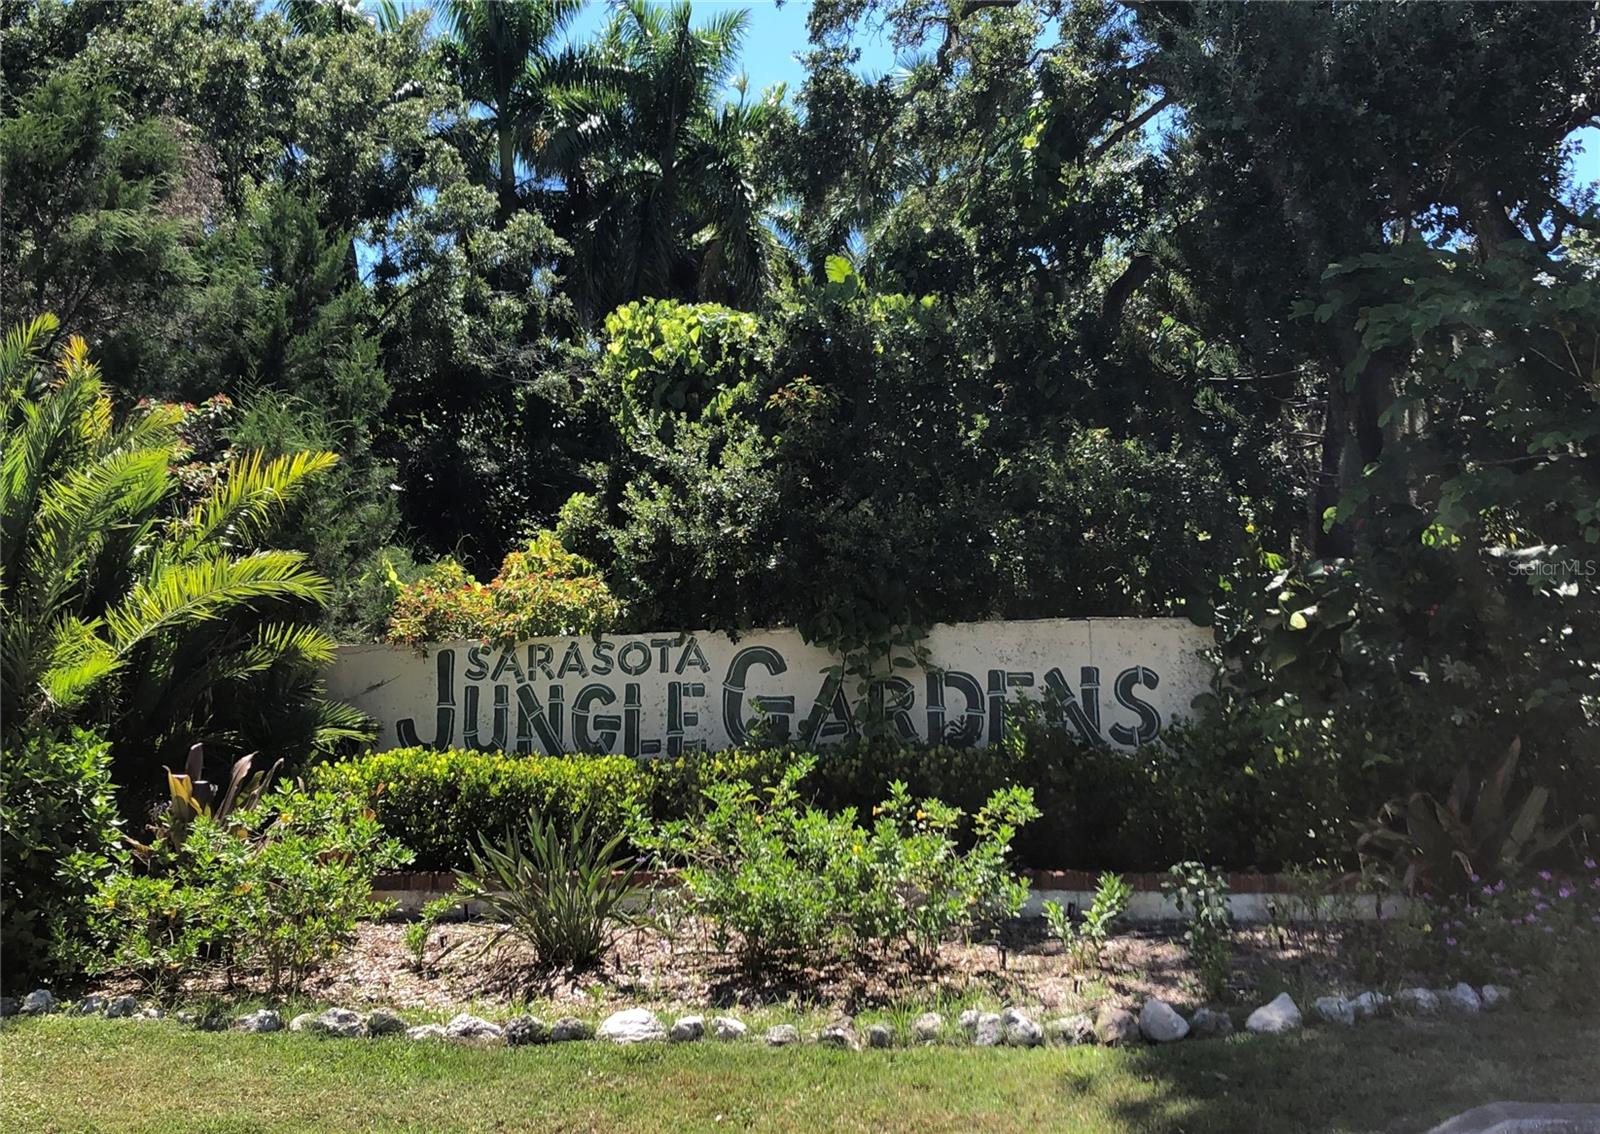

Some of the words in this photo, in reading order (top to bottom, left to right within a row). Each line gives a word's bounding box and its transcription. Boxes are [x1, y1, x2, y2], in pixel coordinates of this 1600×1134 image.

[464, 636, 711, 683] SARASOTA
[396, 648, 707, 757] JUNGLE
[723, 645, 1161, 752] GARDENS
